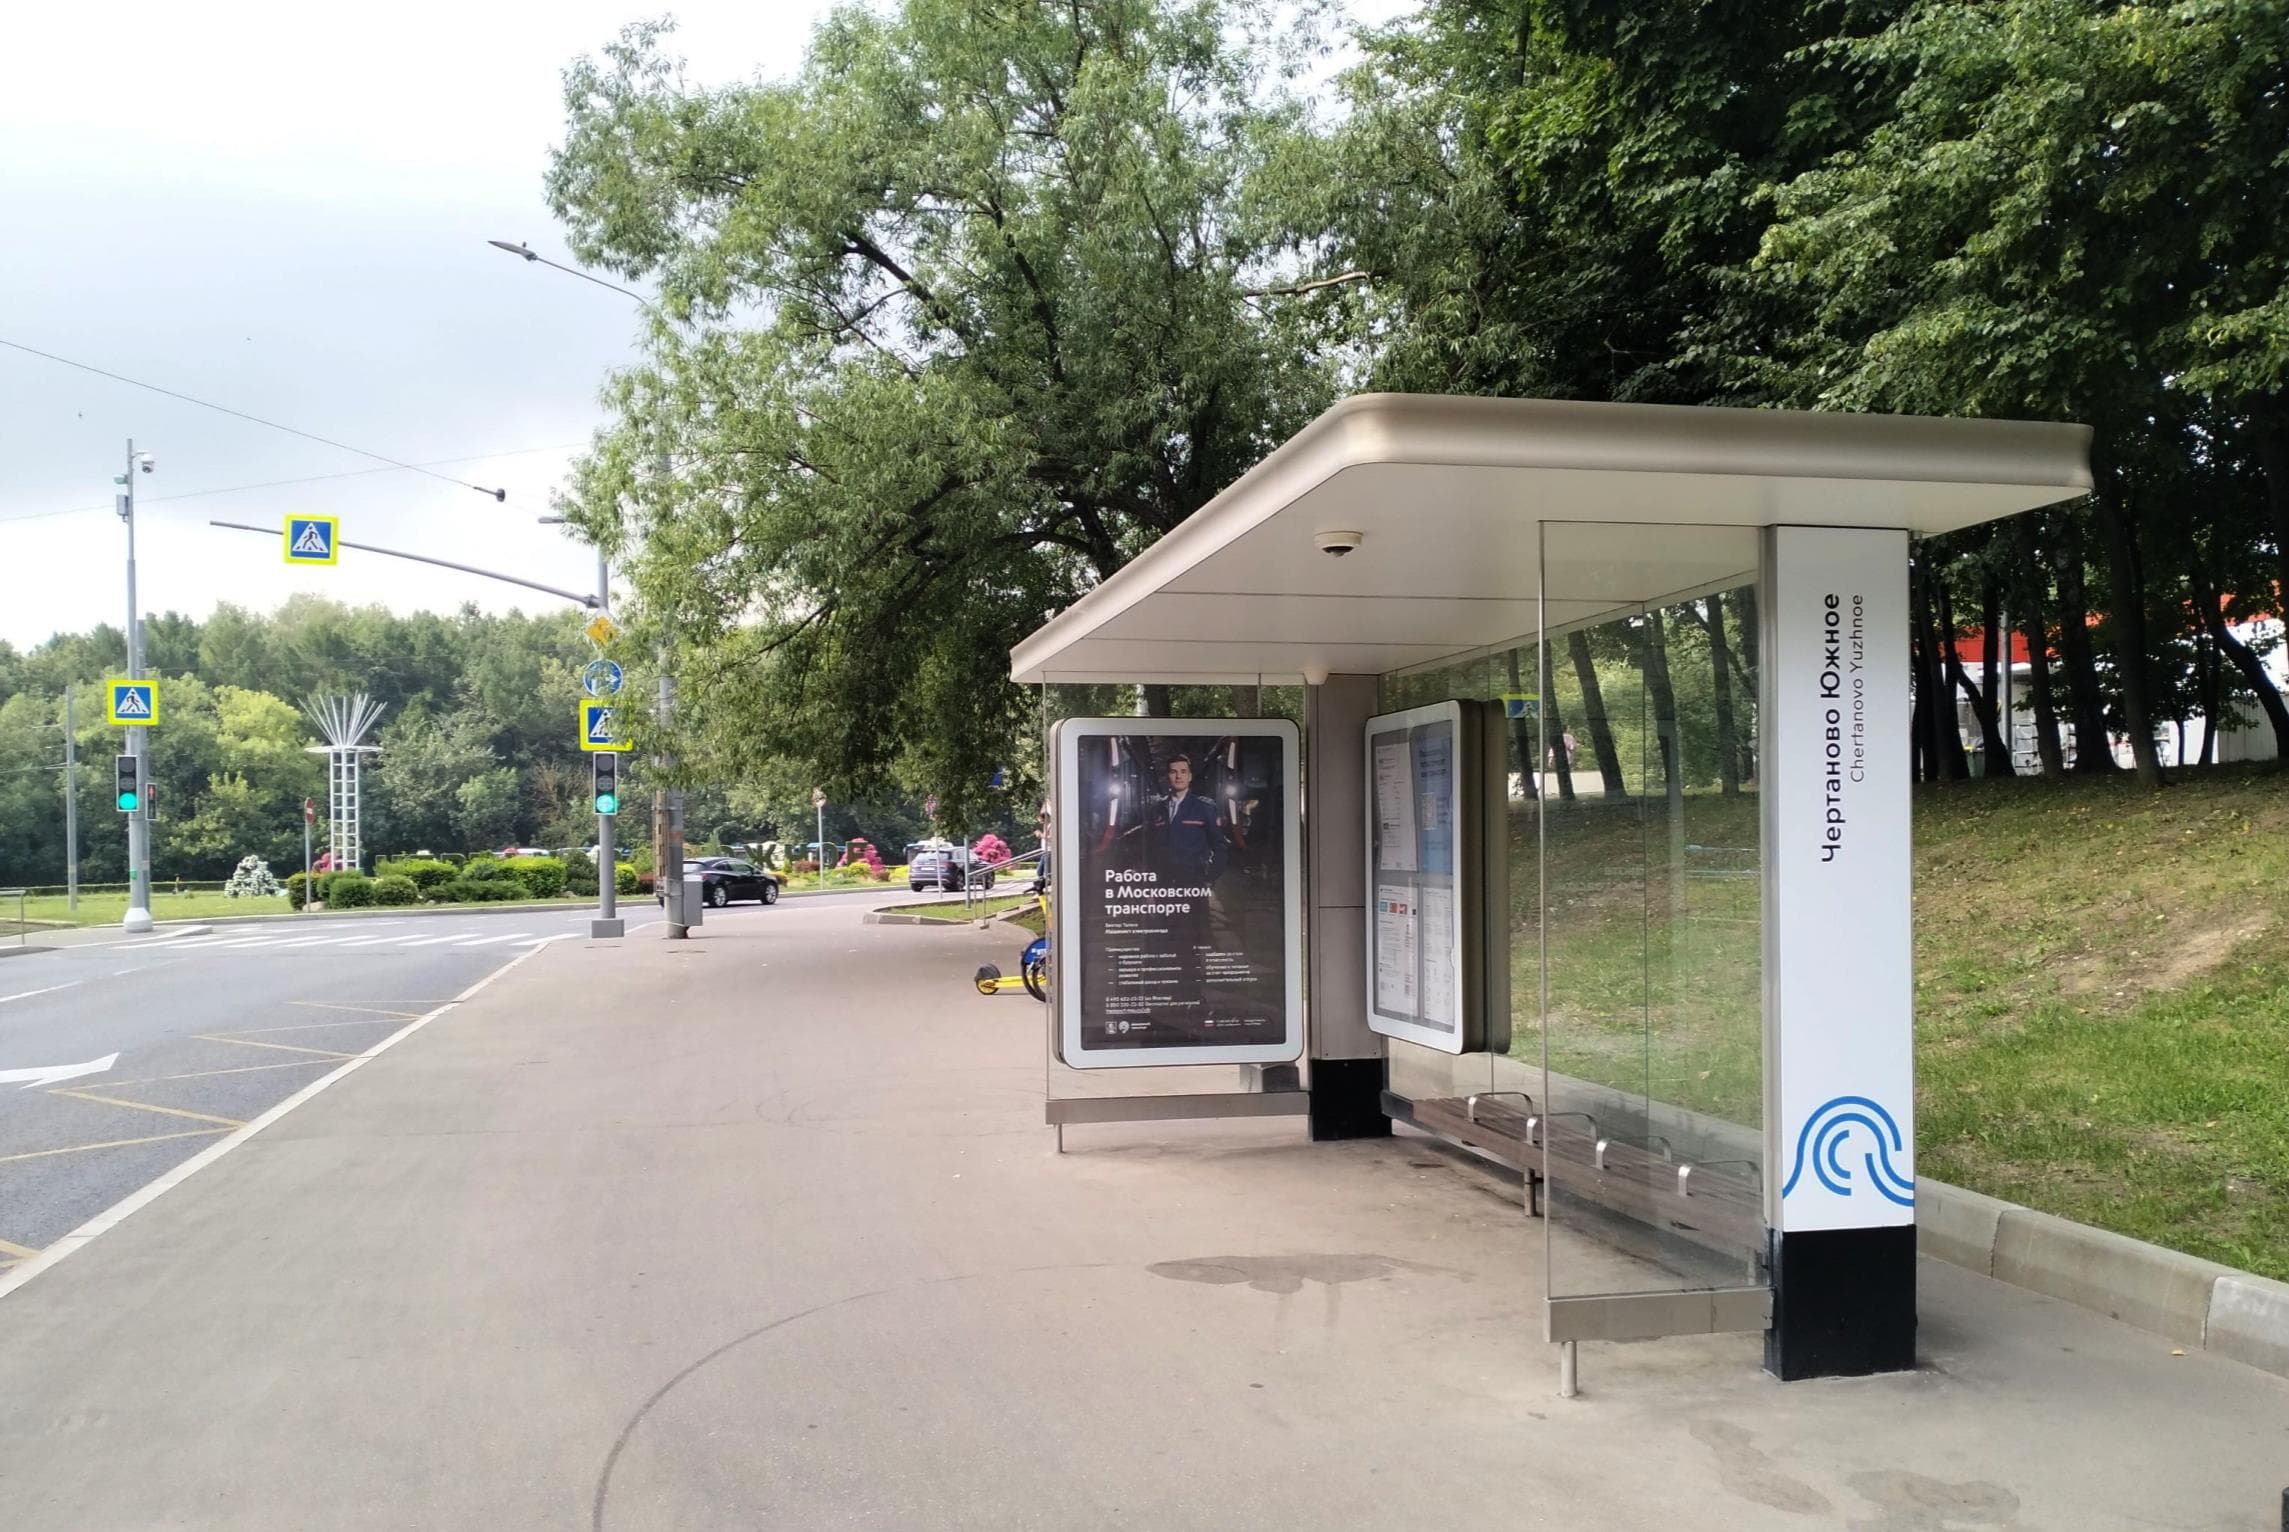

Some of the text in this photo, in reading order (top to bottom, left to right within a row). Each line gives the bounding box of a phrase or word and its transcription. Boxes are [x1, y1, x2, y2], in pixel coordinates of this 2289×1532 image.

[1849, 595, 1864, 782] Chertanovo Yuzhnoe
[1820, 593, 1846, 862] Чертаново Южное
[1105, 869, 1157, 882] Работа
[1105, 885, 1212, 899] в Московском
[1104, 903, 1191, 917] транспорте
